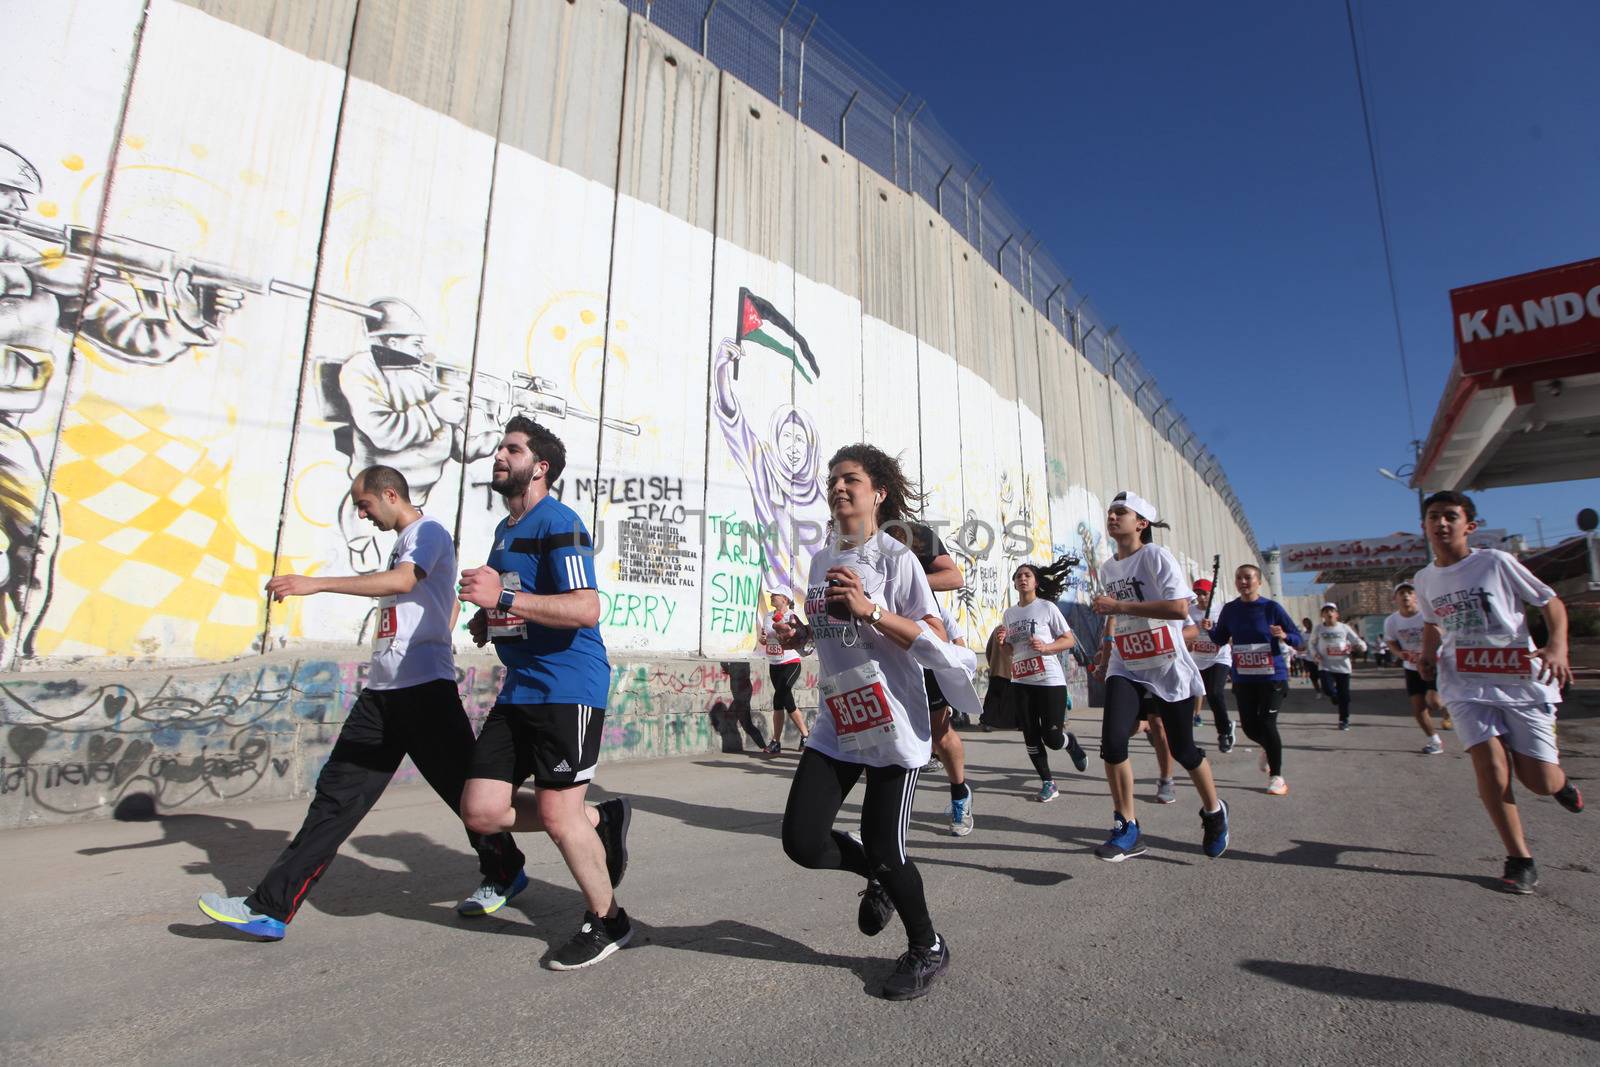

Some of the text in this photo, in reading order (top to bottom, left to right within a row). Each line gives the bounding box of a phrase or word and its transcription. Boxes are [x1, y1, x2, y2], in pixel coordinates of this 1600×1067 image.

[684, 565, 696, 573] ALL
[679, 579, 696, 588] FALL
[711, 573, 760, 608] SINN
[598, 590, 676, 633] DERRY
[711, 607, 754, 633] FEIN
[1123, 628, 1165, 655] 4837
[1238, 653, 1269, 666] 3905
[1464, 650, 1522, 669] 4444
